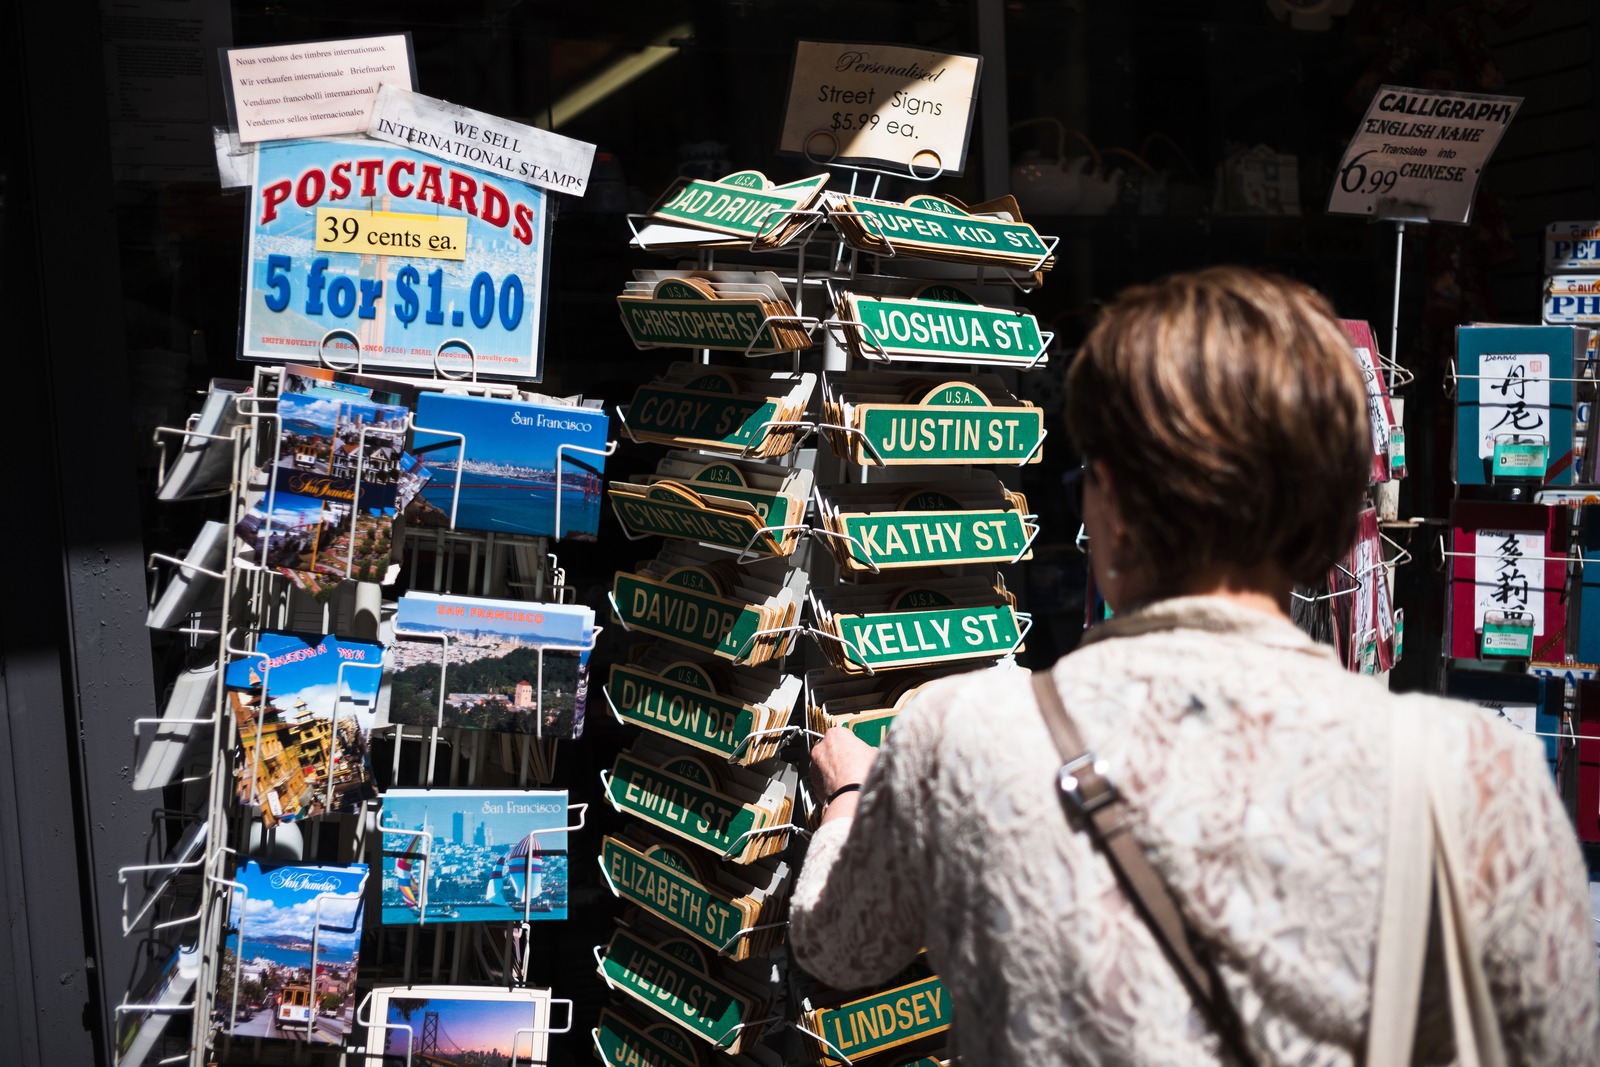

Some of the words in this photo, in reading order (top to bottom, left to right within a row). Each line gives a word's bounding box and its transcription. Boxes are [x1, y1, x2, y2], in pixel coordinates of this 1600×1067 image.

[236, 57, 256, 66] Nous
[257, 54, 288, 64] vendons
[290, 53, 303, 61] des
[304, 49, 332, 59] timbres
[333, 45, 386, 56] internationaux
[835, 51, 946, 84] Personalised
[239, 78, 254, 87] Wir
[256, 74, 293, 85] verkaufen
[294, 69, 344, 82] internationale
[350, 64, 396, 75] Briefmarken
[243, 97, 282, 108] Vendiamo
[283, 91, 323, 103] francobolli
[324, 86, 374, 99] internazionali
[817, 84, 876, 105] Street
[891, 89, 943, 117] Signs
[246, 117, 286, 128] Vendemos
[287, 114, 308, 123] sellos
[309, 108, 365, 121] internacionales
[830, 111, 880, 133] $5.99
[886, 120, 919, 140] ea.
[1365, 118, 1438, 140] ENGLISH
[1435, 125, 1485, 144] NAME
[453, 120, 479, 142] WE
[481, 130, 522, 154] SELL
[1380, 143, 1428, 158] Translate
[1437, 147, 1457, 160] into
[377, 118, 514, 172] INTERNATIONAL
[520, 162, 584, 192] STAMPS
[734, 175, 756, 188] U.S.A.
[1340, 149, 1398, 195] 6.99
[1399, 162, 1467, 183] CHINESE
[261, 159, 533, 246] POSTCARDS
[922, 199, 955, 214] U.S.A.
[323, 216, 360, 244] 39
[367, 226, 421, 248] cents
[428, 234, 458, 252] ea.
[862, 209, 949, 239] SUPER
[952, 224, 997, 244] KID
[1003, 231, 1041, 249] ST.
[264, 253, 291, 313] 5
[305, 257, 383, 320] for
[394, 263, 525, 331] $1.00
[667, 286, 692, 299] U.S.A.
[632, 308, 740, 340] CHRISTOPHER
[736, 311, 769, 341] ST.
[874, 309, 990, 348] JOSHUA
[992, 319, 1034, 351] ST.
[261, 336, 285, 346] SMITH
[285, 338, 317, 348] NOVELTY
[410, 348, 433, 357] EMAIL
[945, 390, 972, 404] U.S.A.
[511, 411, 534, 427] San
[536, 413, 593, 432] Francisco
[639, 396, 711, 431] CORY
[715, 405, 757, 438] ST.
[882, 418, 981, 452] JUSTIN
[987, 419, 1024, 452] ST.
[710, 469, 732, 483] U.S.A.
[623, 502, 717, 541] CYNTHIA
[859, 522, 962, 557] KATHY
[972, 520, 1019, 551] ST.
[437, 604, 465, 617] SAN
[469, 607, 545, 625] FRANCISCO
[632, 587, 700, 634] DAVID
[702, 607, 738, 648] DR.
[853, 617, 951, 657] KELLY
[961, 614, 1012, 646] ST.
[621, 679, 702, 734] DILLON
[704, 705, 739, 748] DR.
[481, 800, 504, 815] San
[506, 801, 561, 814] Francisco
[625, 770, 698, 825] EMILY
[696, 801, 733, 844] ST.
[270, 868, 299, 890] San
[293, 872, 342, 892] Francisco
[611, 851, 702, 927] ELIZABETH
[622, 950, 686, 1007] HEIDI
[682, 984, 718, 1029] ST.
[834, 987, 942, 1050] LINDSEY
